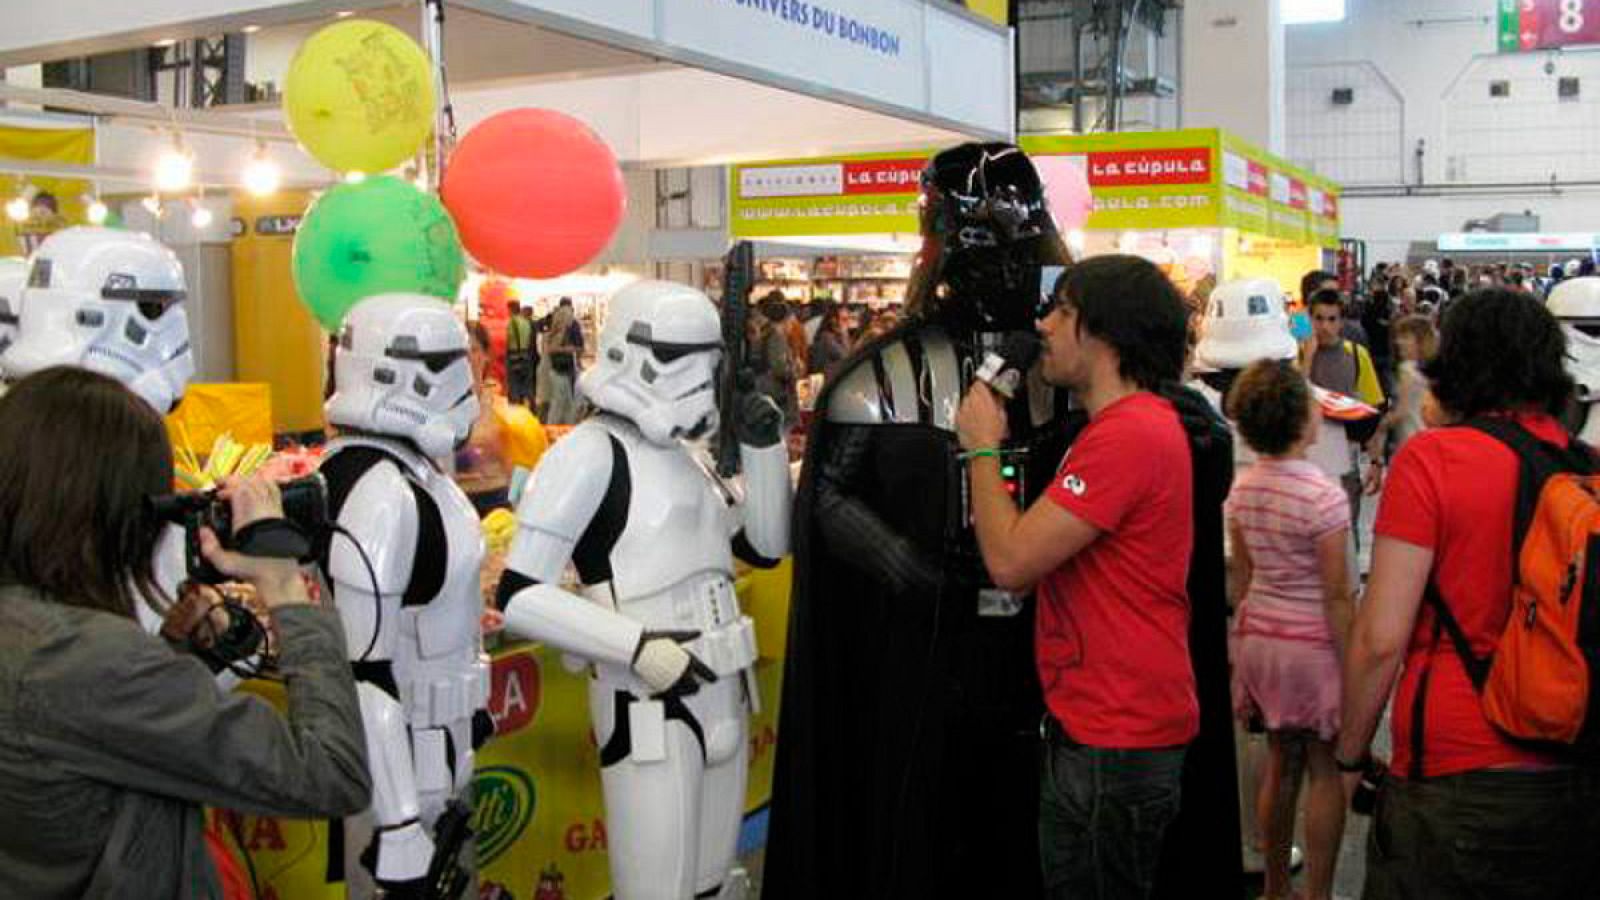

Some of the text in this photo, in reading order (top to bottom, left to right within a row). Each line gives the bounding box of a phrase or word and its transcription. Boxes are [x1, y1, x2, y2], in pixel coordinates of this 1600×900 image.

[736, 0, 900, 56] IVERS DU BONBON
[1560, 0, 1584, 33] 8
